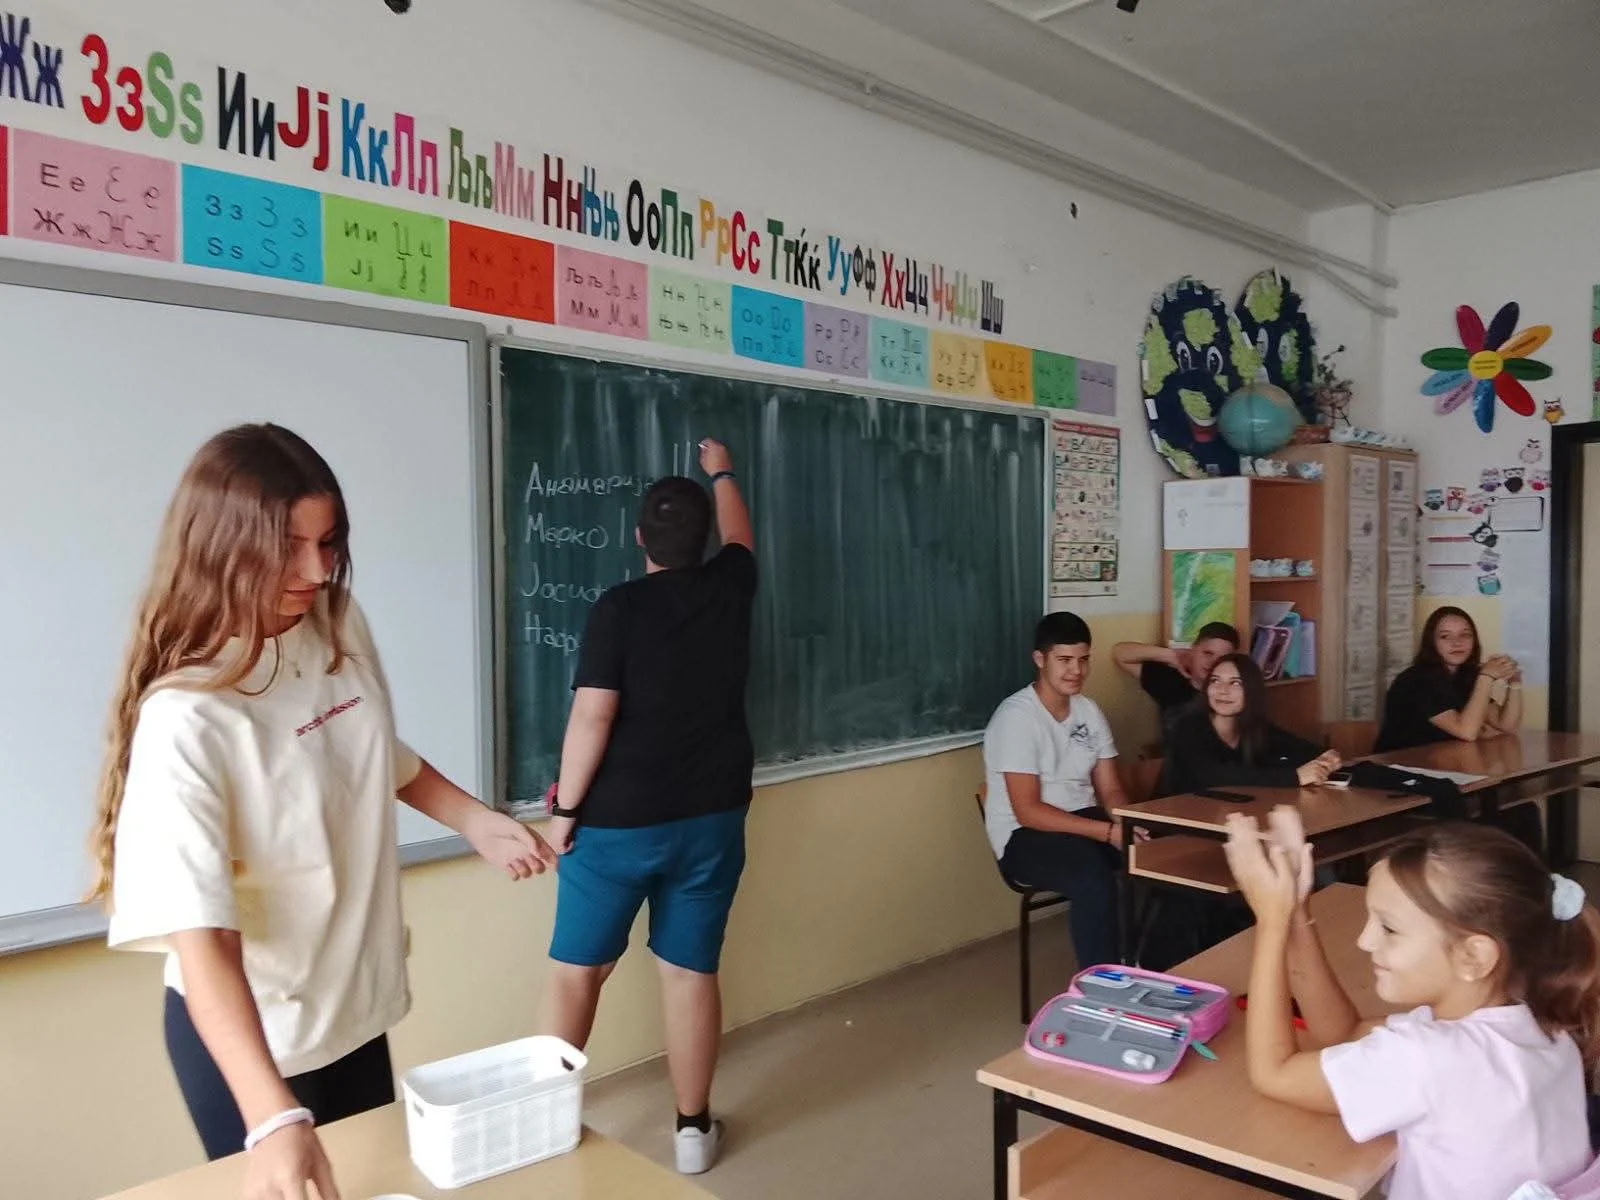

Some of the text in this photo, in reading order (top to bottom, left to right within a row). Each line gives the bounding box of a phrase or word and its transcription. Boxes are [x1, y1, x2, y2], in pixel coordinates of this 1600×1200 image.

[0, 12, 64, 109] Жж
[81, 33, 144, 132] Зз
[217, 65, 276, 162] Ии
[341, 97, 389, 188] Кк
[391, 112, 440, 197] Лл
[494, 141, 535, 222] Мм
[543, 153, 585, 234] Нн
[626, 179, 661, 251] Оо
[661, 187, 694, 261] Пп
[699, 198, 731, 266] Рр
[731, 210, 761, 275] Сс
[827, 235, 852, 297] Уу
[853, 244, 877, 303] Фф
[881, 250, 905, 311] Хх
